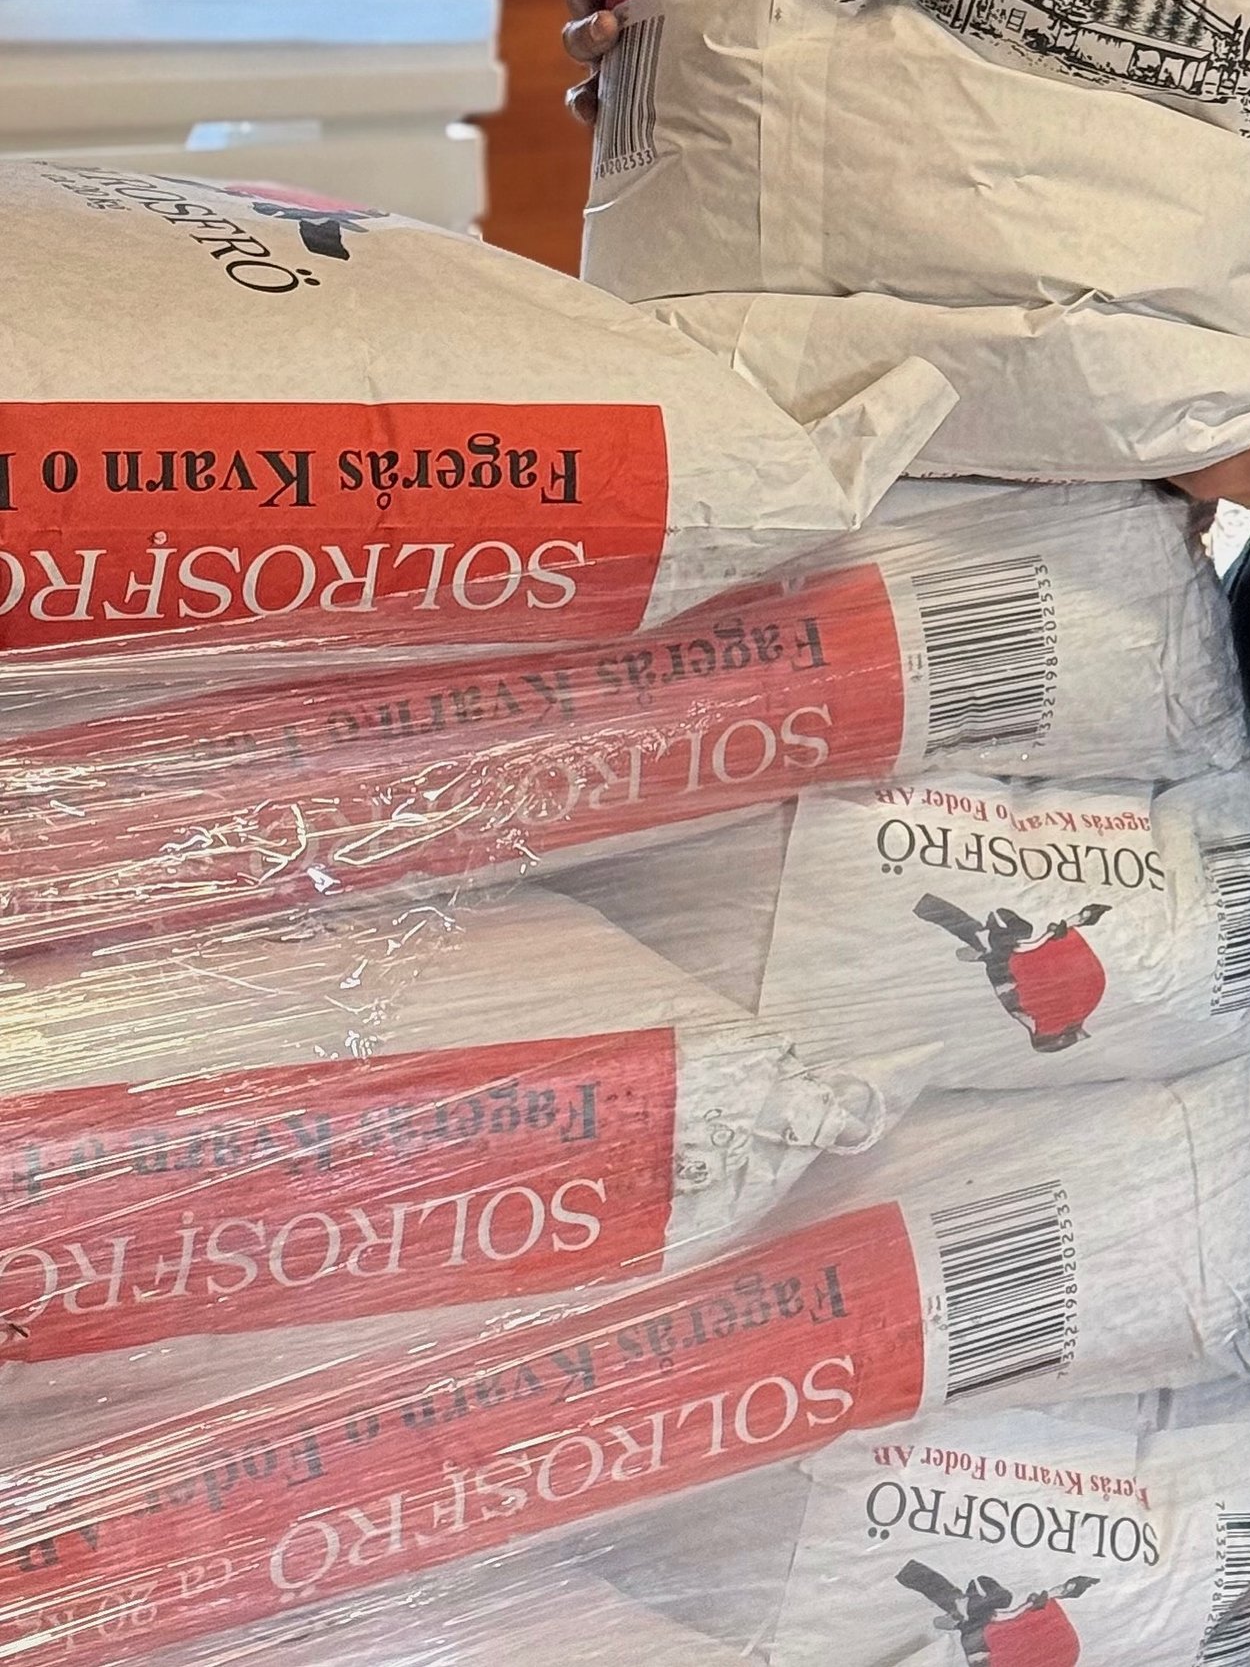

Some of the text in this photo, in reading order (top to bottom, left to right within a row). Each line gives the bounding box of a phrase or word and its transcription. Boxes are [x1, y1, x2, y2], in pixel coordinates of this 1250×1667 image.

[56, 165, 321, 293] ROSFRÖ
[41, 449, 79, 494] o
[102, 447, 317, 510] Kvarn
[340, 432, 583, 511] Fagerås
[596, 615, 829, 709] Fagerås
[921, 787, 989, 823] Foder
[995, 803, 1008, 821] o
[1082, 811, 1151, 836] agerås
[877, 819, 1165, 892] SOLROSFRÖ
[617, 1261, 849, 1373] Fagerås
[401, 1344, 597, 1429] Kvarn
[268, 1354, 858, 1605] SOLROSFRÖ
[920, 1446, 986, 1481] Foder
[994, 1458, 1007, 1477] o
[1013, 1461, 1084, 1496] Kvarn
[866, 1481, 1160, 1567] SOLROSFRÖ
